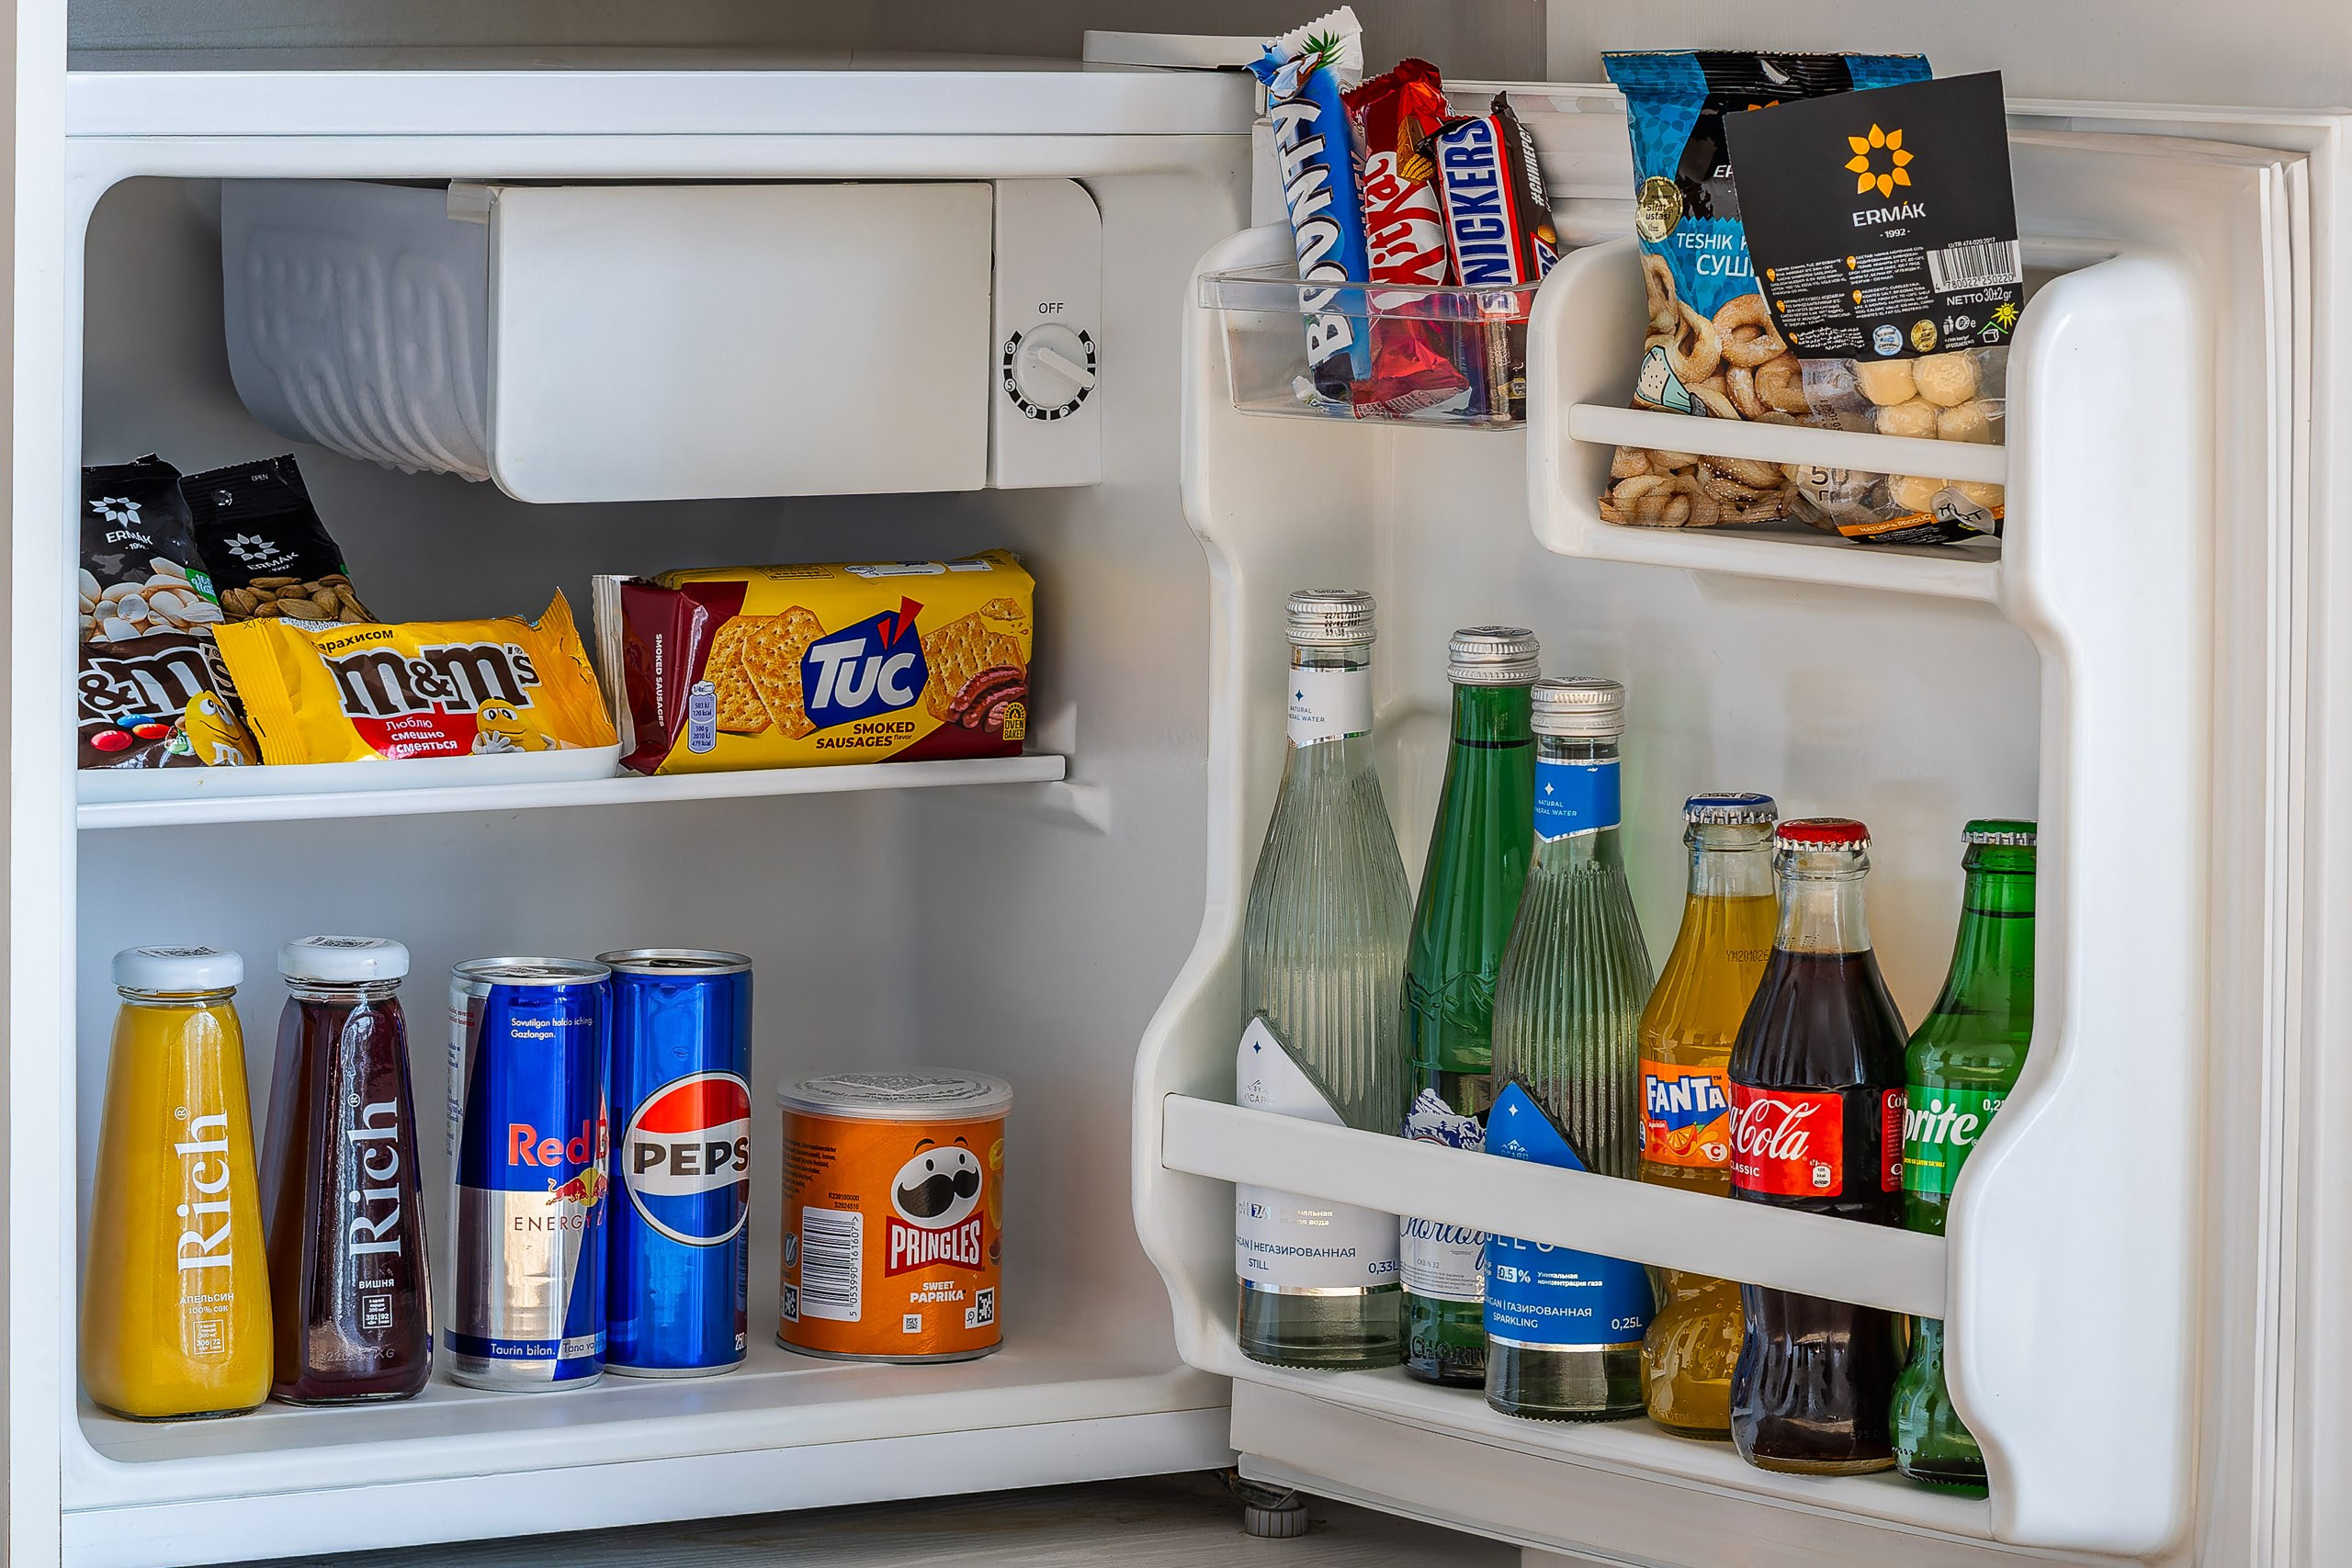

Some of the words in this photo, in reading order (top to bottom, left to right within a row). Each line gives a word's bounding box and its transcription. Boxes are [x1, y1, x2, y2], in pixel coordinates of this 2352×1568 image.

[1646, 199, 1667, 211] Sifat
[1645, 212, 1671, 220] ustasi
[1271, 98, 1353, 367] BOUNTY
[1884, 228, 1906, 239] 1992
[1677, 233, 1733, 251] TESHIK
[1696, 254, 1754, 277] СУШ
[1946, 277, 1978, 290] 780022
[1982, 273, 2014, 286] 250220
[1946, 293, 1983, 306] NETTO
[1038, 302, 1064, 313] OFF
[1860, 522, 1897, 533] NATURAL
[655, 677, 665, 728] SAUSAGES
[385, 716, 433, 732] Люблю
[1004, 719, 1025, 730] OVEN
[1301, 715, 1325, 723] WATER
[854, 722, 916, 735] SMOKED
[1004, 729, 1025, 739] BAKED
[390, 729, 445, 742] смешно
[396, 739, 458, 754] смеяться
[816, 735, 892, 750] SAUSAGES
[1538, 798, 1564, 807] NATURAL
[1552, 808, 1577, 817] WATER
[511, 1018, 550, 1029] Sovutilgan
[511, 1030, 557, 1041] Gazlangan.
[1902, 1099, 1979, 1149] prite
[508, 1119, 591, 1168] Red
[633, 1136, 750, 1177] PEPS
[346, 1097, 401, 1258] Rich
[174, 1110, 232, 1274] Rich
[514, 1214, 592, 1231] ENERGY
[849, 1225, 861, 1266] 161607
[890, 1219, 980, 1270] PRINGLES
[1253, 1241, 1356, 1258] НЕГАЗИРОВАННАЯ
[1248, 1258, 1269, 1270] STILL
[1368, 1260, 1399, 1275] 0,33L
[1432, 1260, 1440, 1269] 32
[1537, 1270, 1578, 1280] Уникальная
[358, 1279, 395, 1289] ВИШНЯ
[850, 1266, 861, 1307] 053990
[922, 1280, 955, 1291] SWEET
[1537, 1279, 1587, 1287] концентрация
[179, 1292, 234, 1304] АПЕЛЬСИН
[910, 1290, 964, 1303] PAPRIKA
[188, 1306, 212, 1314] 100%
[1507, 1303, 1592, 1317] ГАЗИРОВАННАЯ
[1493, 1312, 1539, 1328] SPARKLING
[1611, 1317, 1643, 1331] 0,25L
[491, 1343, 524, 1356] Taurin
[526, 1343, 556, 1357] bilan.
[563, 1342, 584, 1353] Tana
